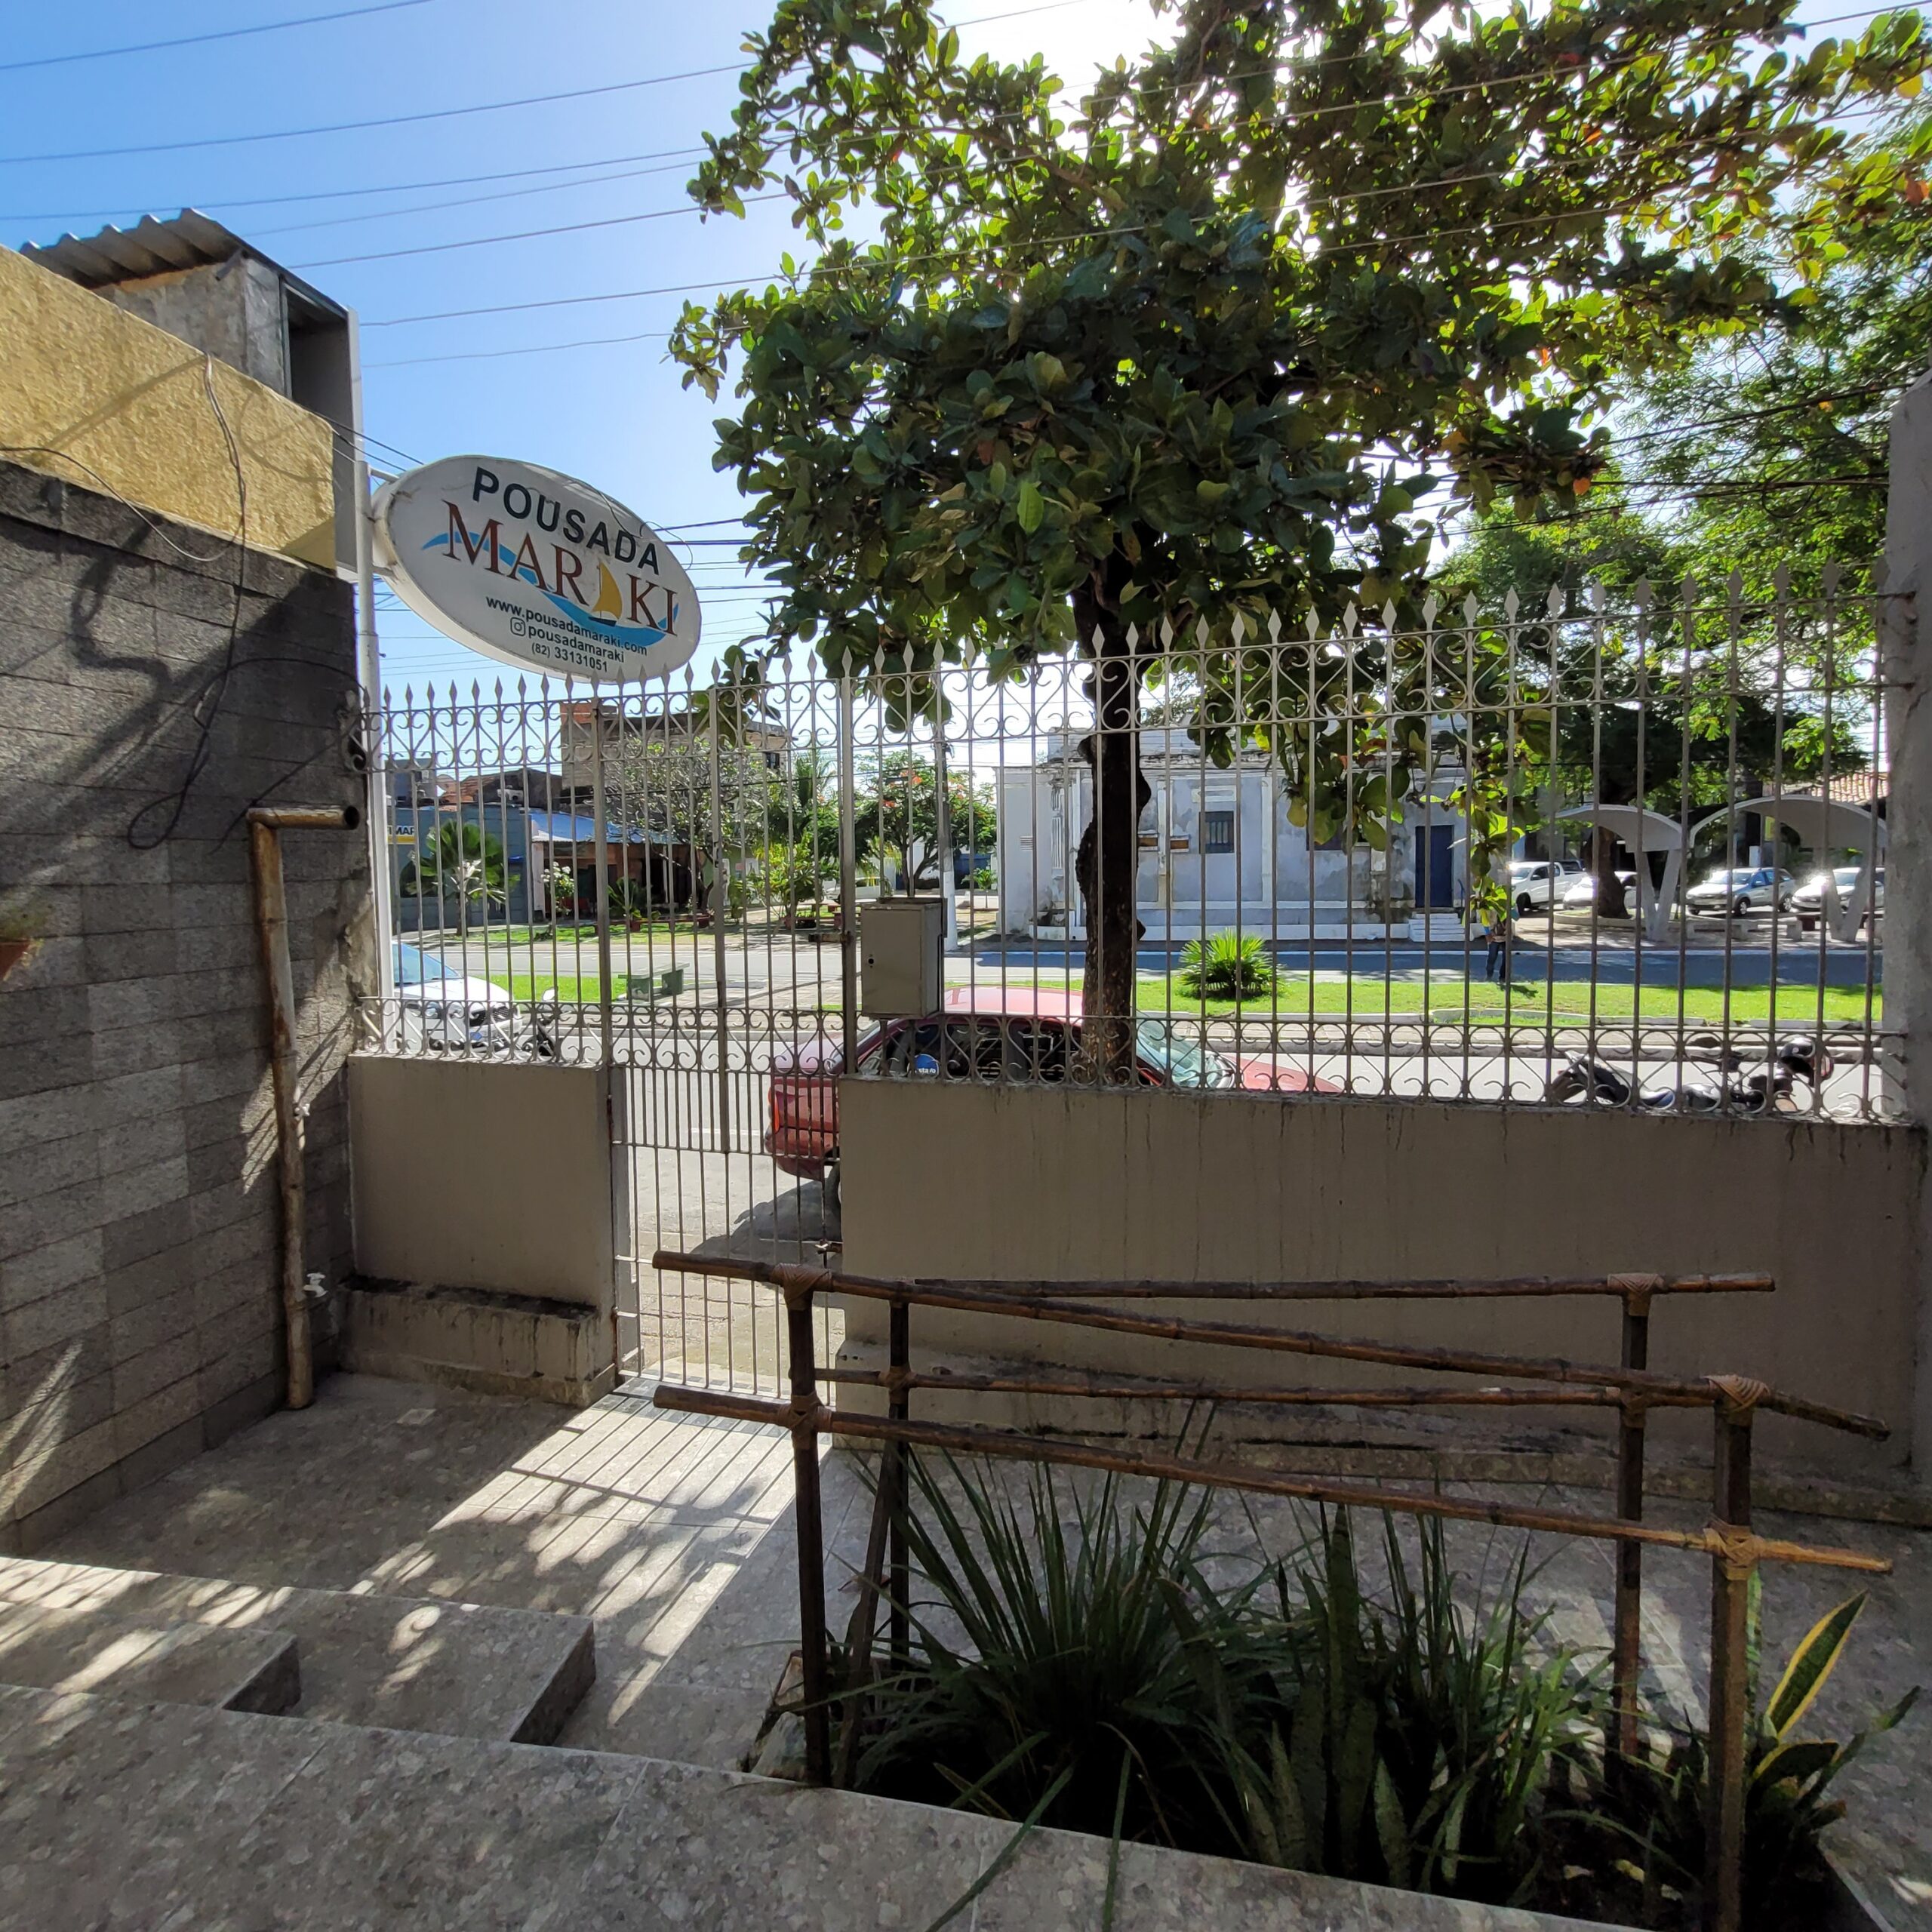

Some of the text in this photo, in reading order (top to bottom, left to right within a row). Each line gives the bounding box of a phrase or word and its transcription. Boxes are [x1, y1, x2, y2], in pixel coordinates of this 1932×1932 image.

[472, 466, 660, 575] POUSADA
[486, 596, 648, 656] www.pousadamaraki.com
[528, 624, 625, 663] pousadamaraki
[531, 642, 608, 672] (82) 33131051
